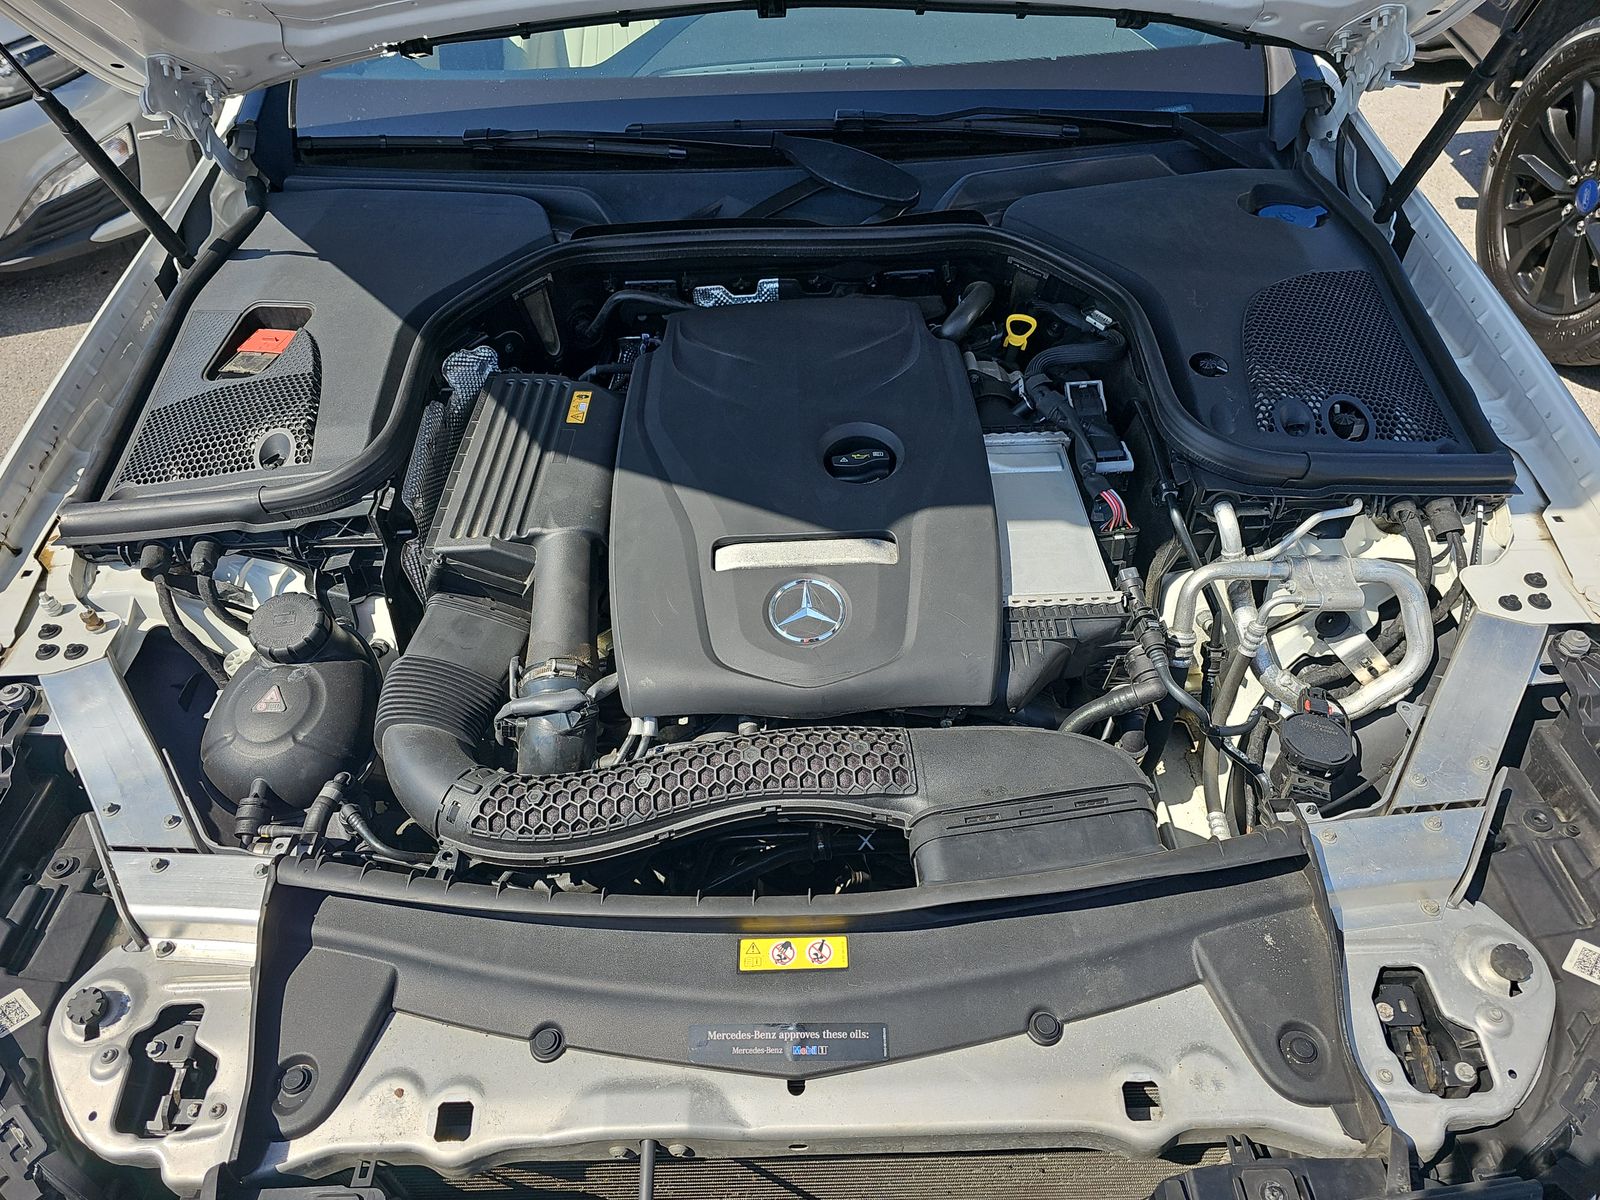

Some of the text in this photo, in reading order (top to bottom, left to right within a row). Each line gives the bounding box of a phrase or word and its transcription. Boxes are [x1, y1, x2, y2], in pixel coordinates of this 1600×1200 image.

[707, 1030, 870, 1041] Mercedes-Benz approves these oils:
[731, 1046, 784, 1055] Mercedes-Benz
